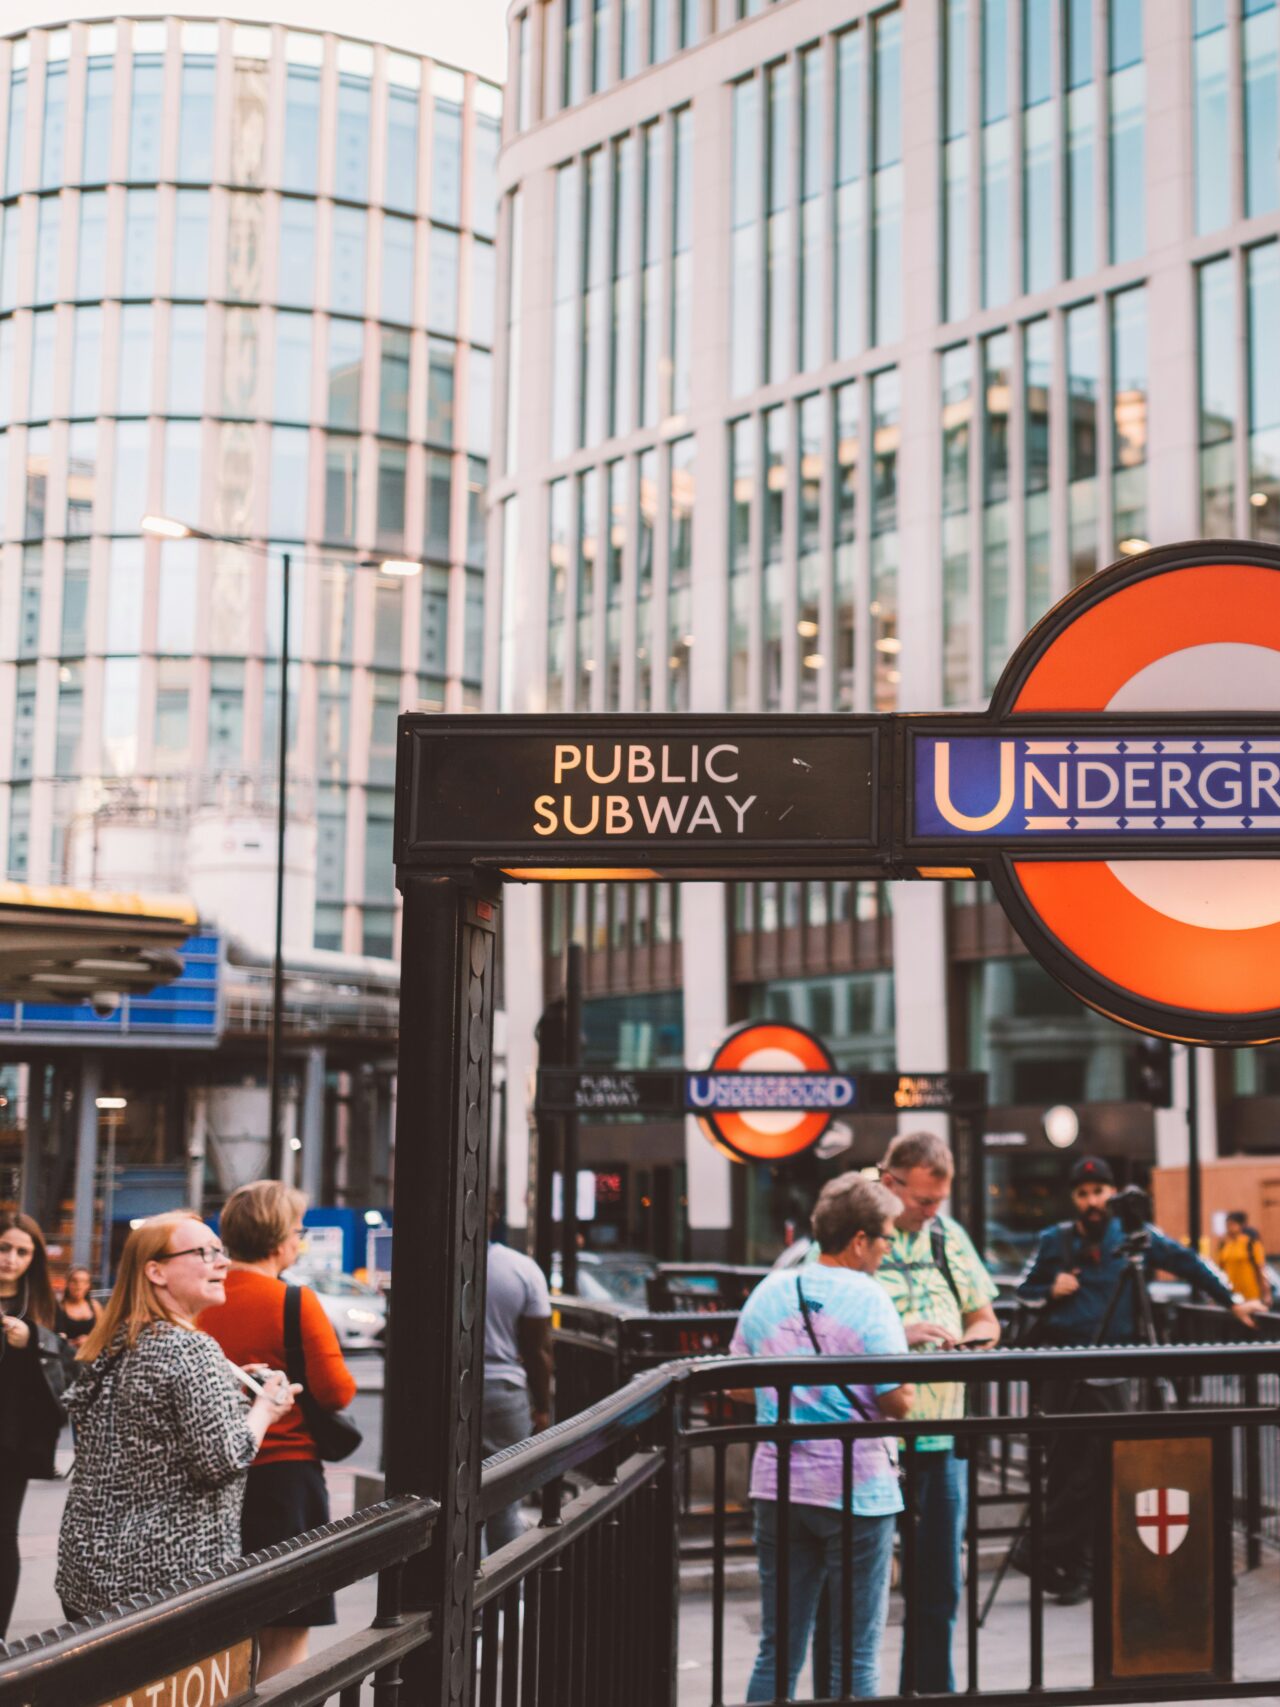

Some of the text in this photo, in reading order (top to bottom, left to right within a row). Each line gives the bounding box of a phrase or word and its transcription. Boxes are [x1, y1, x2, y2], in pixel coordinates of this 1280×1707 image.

[554, 744, 739, 784] PUBLIC
[532, 794, 758, 836] SUBWAY
[580, 1075, 636, 1090] PUBLIC
[575, 1091, 640, 1107] SUBWAY
